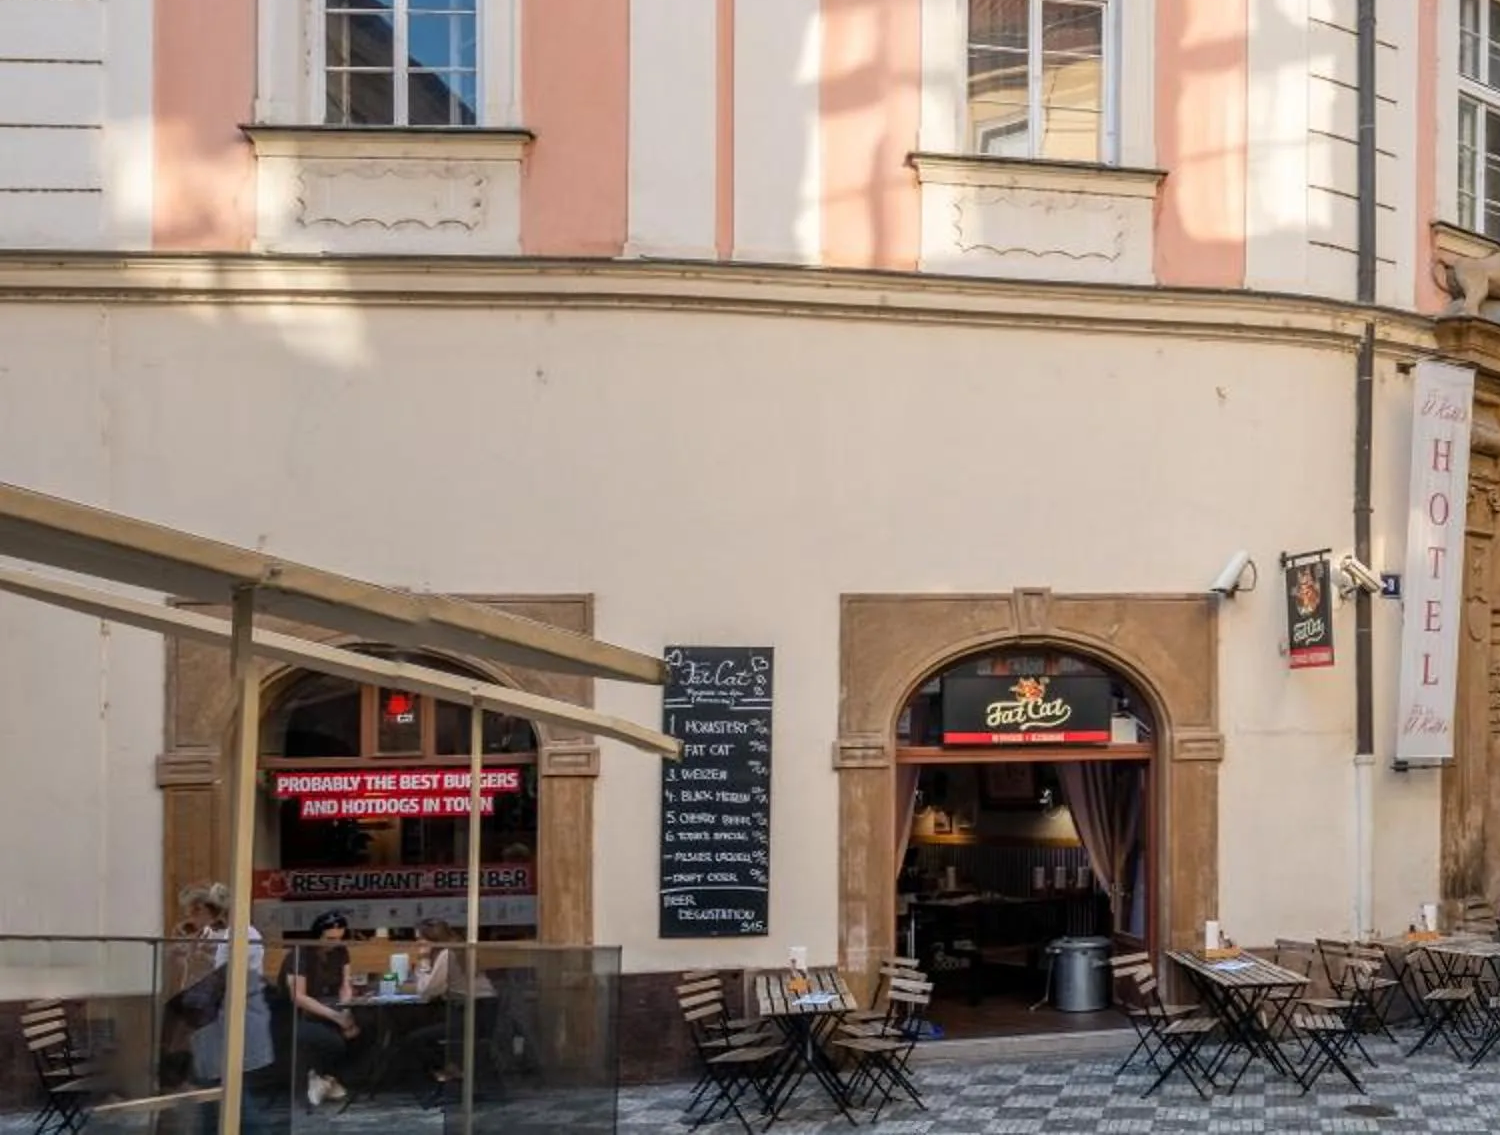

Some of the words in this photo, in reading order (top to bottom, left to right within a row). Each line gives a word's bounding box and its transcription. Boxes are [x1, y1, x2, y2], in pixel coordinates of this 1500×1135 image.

[1422, 438, 1453, 686] HOTEL
[715, 660, 753, 686] Cat
[986, 700, 1027, 727] Fat
[685, 744, 706, 757] FAT
[709, 744, 736, 756] CAT
[277, 775, 360, 793] PROBABLY
[363, 774, 397, 791] THE
[399, 773, 440, 791] BEST
[681, 768, 728, 780] WEIZEN
[303, 798, 338, 816] AND
[341, 797, 420, 815] HOTDOGS
[422, 797, 440, 813] IN
[291, 872, 424, 893] RESTAURANT
[488, 868, 527, 888] BAR
